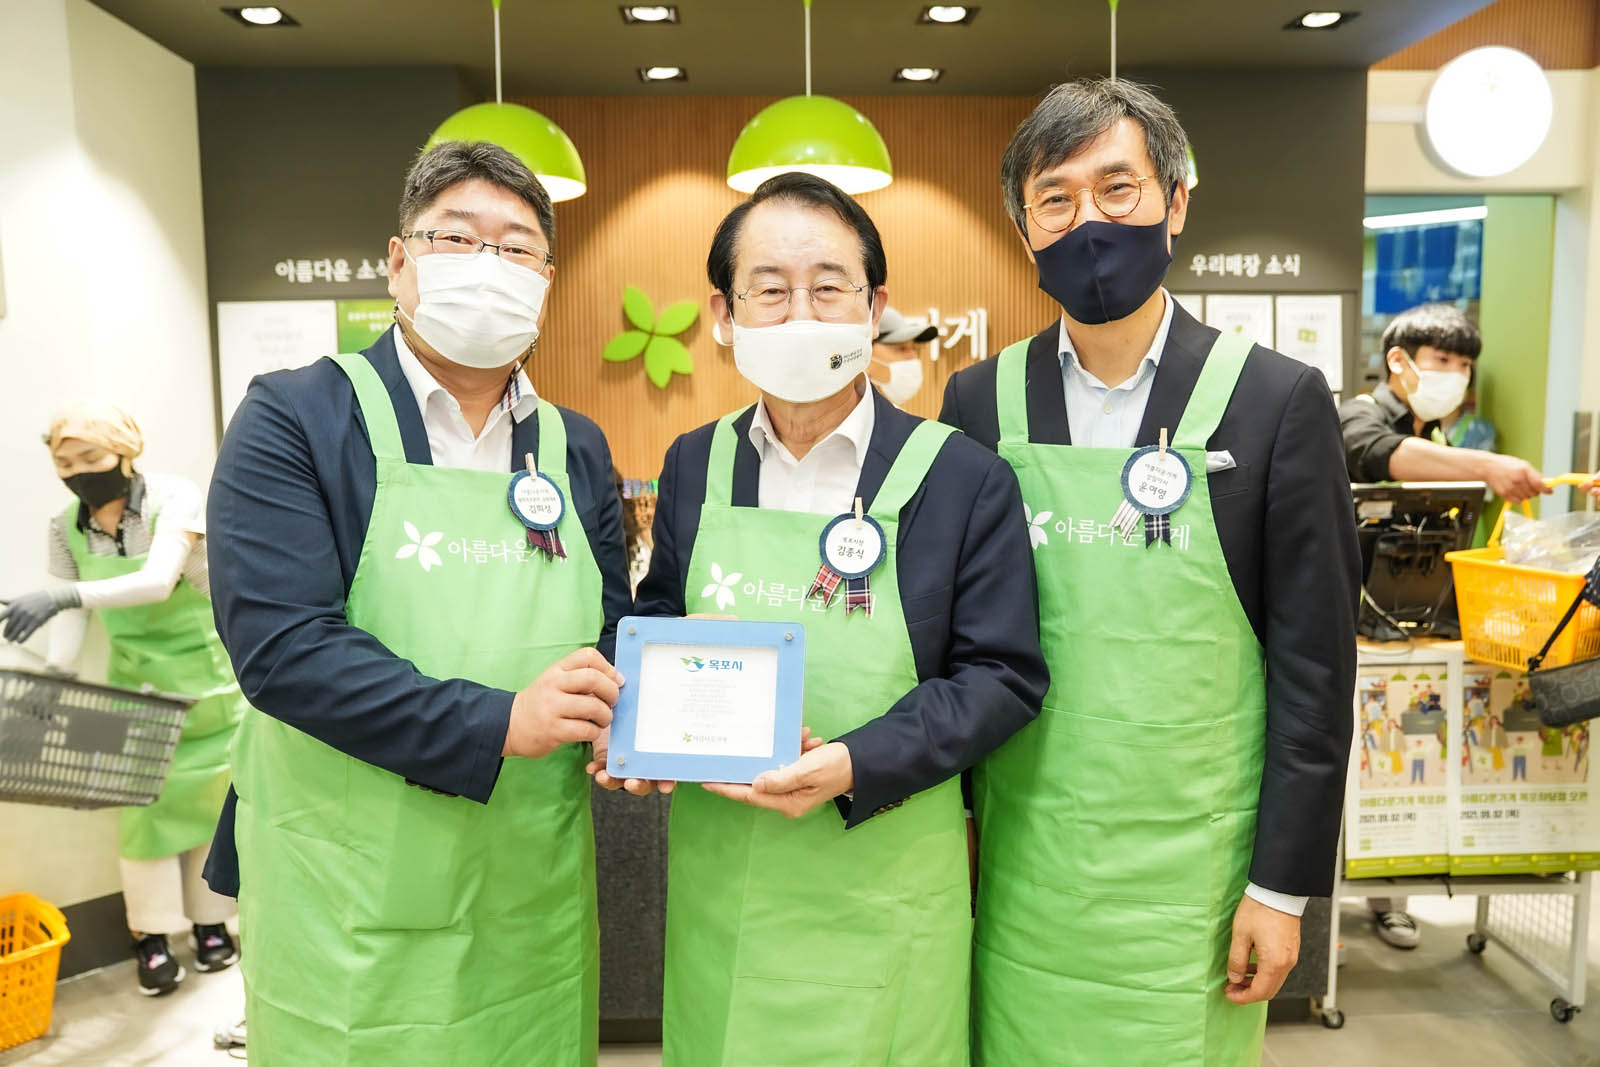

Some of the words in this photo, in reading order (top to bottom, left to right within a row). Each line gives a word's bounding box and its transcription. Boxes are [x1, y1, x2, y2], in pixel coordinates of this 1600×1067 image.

[275, 258, 352, 283] 아름다운
[1189, 253, 1261, 278] 우리매장
[1264, 253, 1300, 277] 소식
[1138, 481, 1167, 500] 윤여영
[709, 659, 743, 671] 목포시
